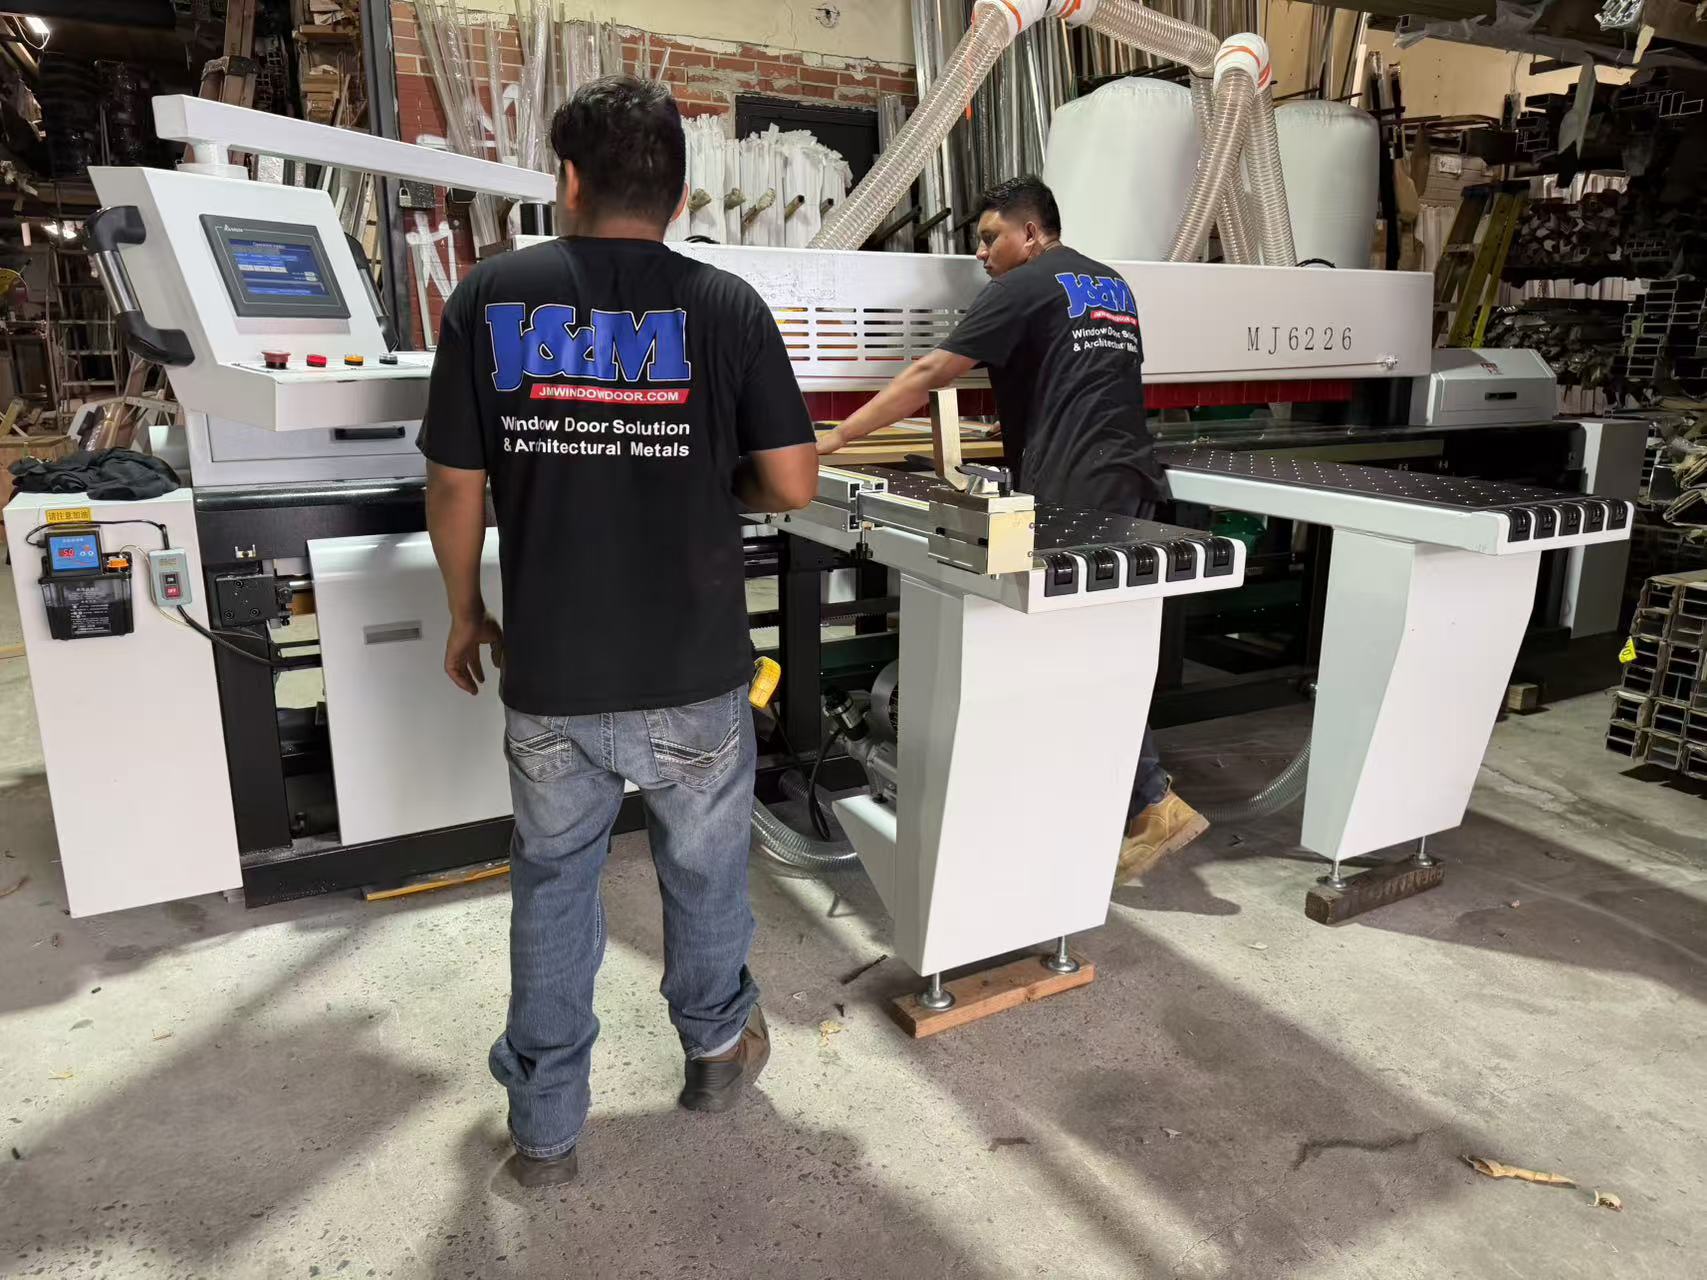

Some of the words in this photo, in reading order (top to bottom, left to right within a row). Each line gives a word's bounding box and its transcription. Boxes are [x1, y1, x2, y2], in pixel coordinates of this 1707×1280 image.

[485, 302, 691, 391] J&M
[1247, 326, 1352, 355] MJ6226
[538, 386, 680, 402] JMWINDOWDOOR.COM
[501, 415, 559, 432] Window
[564, 417, 610, 434] Door
[612, 419, 691, 436] Solution
[503, 437, 512, 452] &
[515, 437, 621, 456] Architectural
[630, 441, 690, 458] Metals
